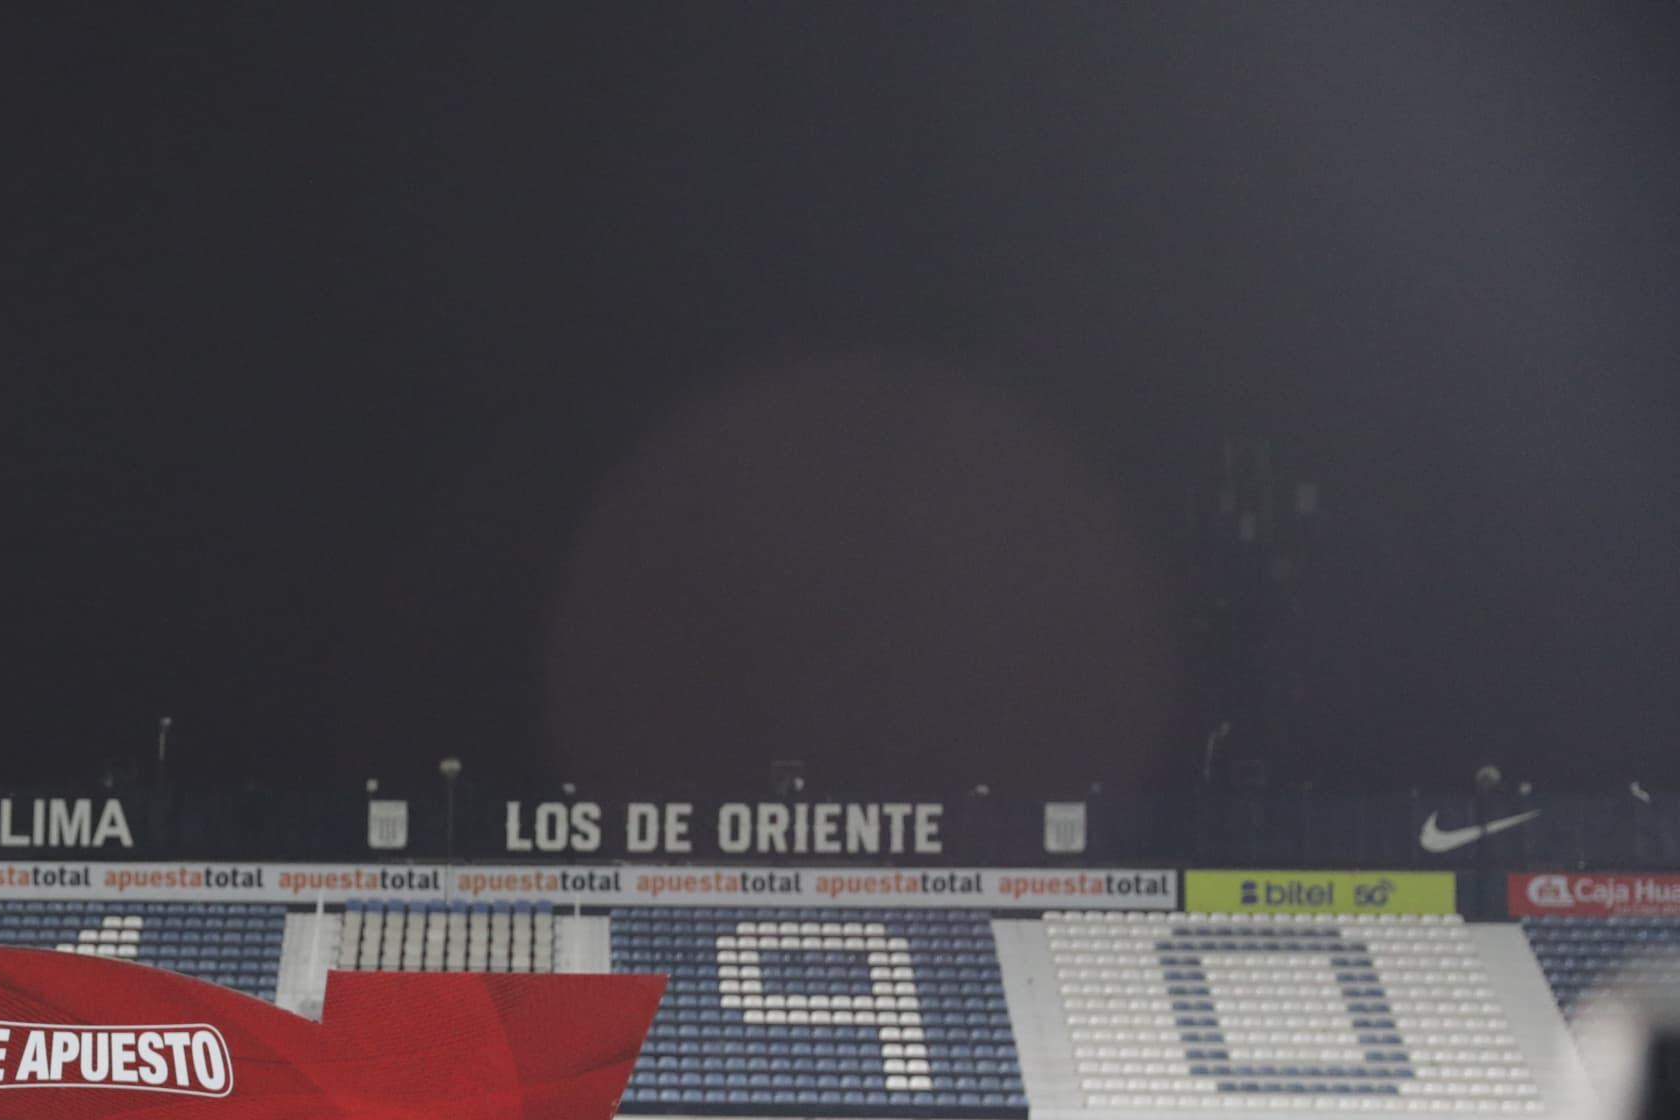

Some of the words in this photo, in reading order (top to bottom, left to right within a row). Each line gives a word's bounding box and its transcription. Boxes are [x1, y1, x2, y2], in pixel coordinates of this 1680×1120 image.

[0, 798, 133, 848] LIMA
[506, 801, 602, 852] LOS
[627, 802, 693, 852] DE
[718, 802, 943, 853] ORIENTE
[103, 867, 263, 893] apuestatotal
[278, 868, 440, 894] apuestatotal
[457, 870, 622, 895] apuestatotal
[635, 870, 803, 896] apuestatotal
[815, 871, 983, 898] apuestatotal
[998, 872, 1169, 898] apuestatotal
[1265, 881, 1334, 906] bitel
[1573, 876, 1630, 908] Caja
[15, 1029, 226, 1091] APUESTO
